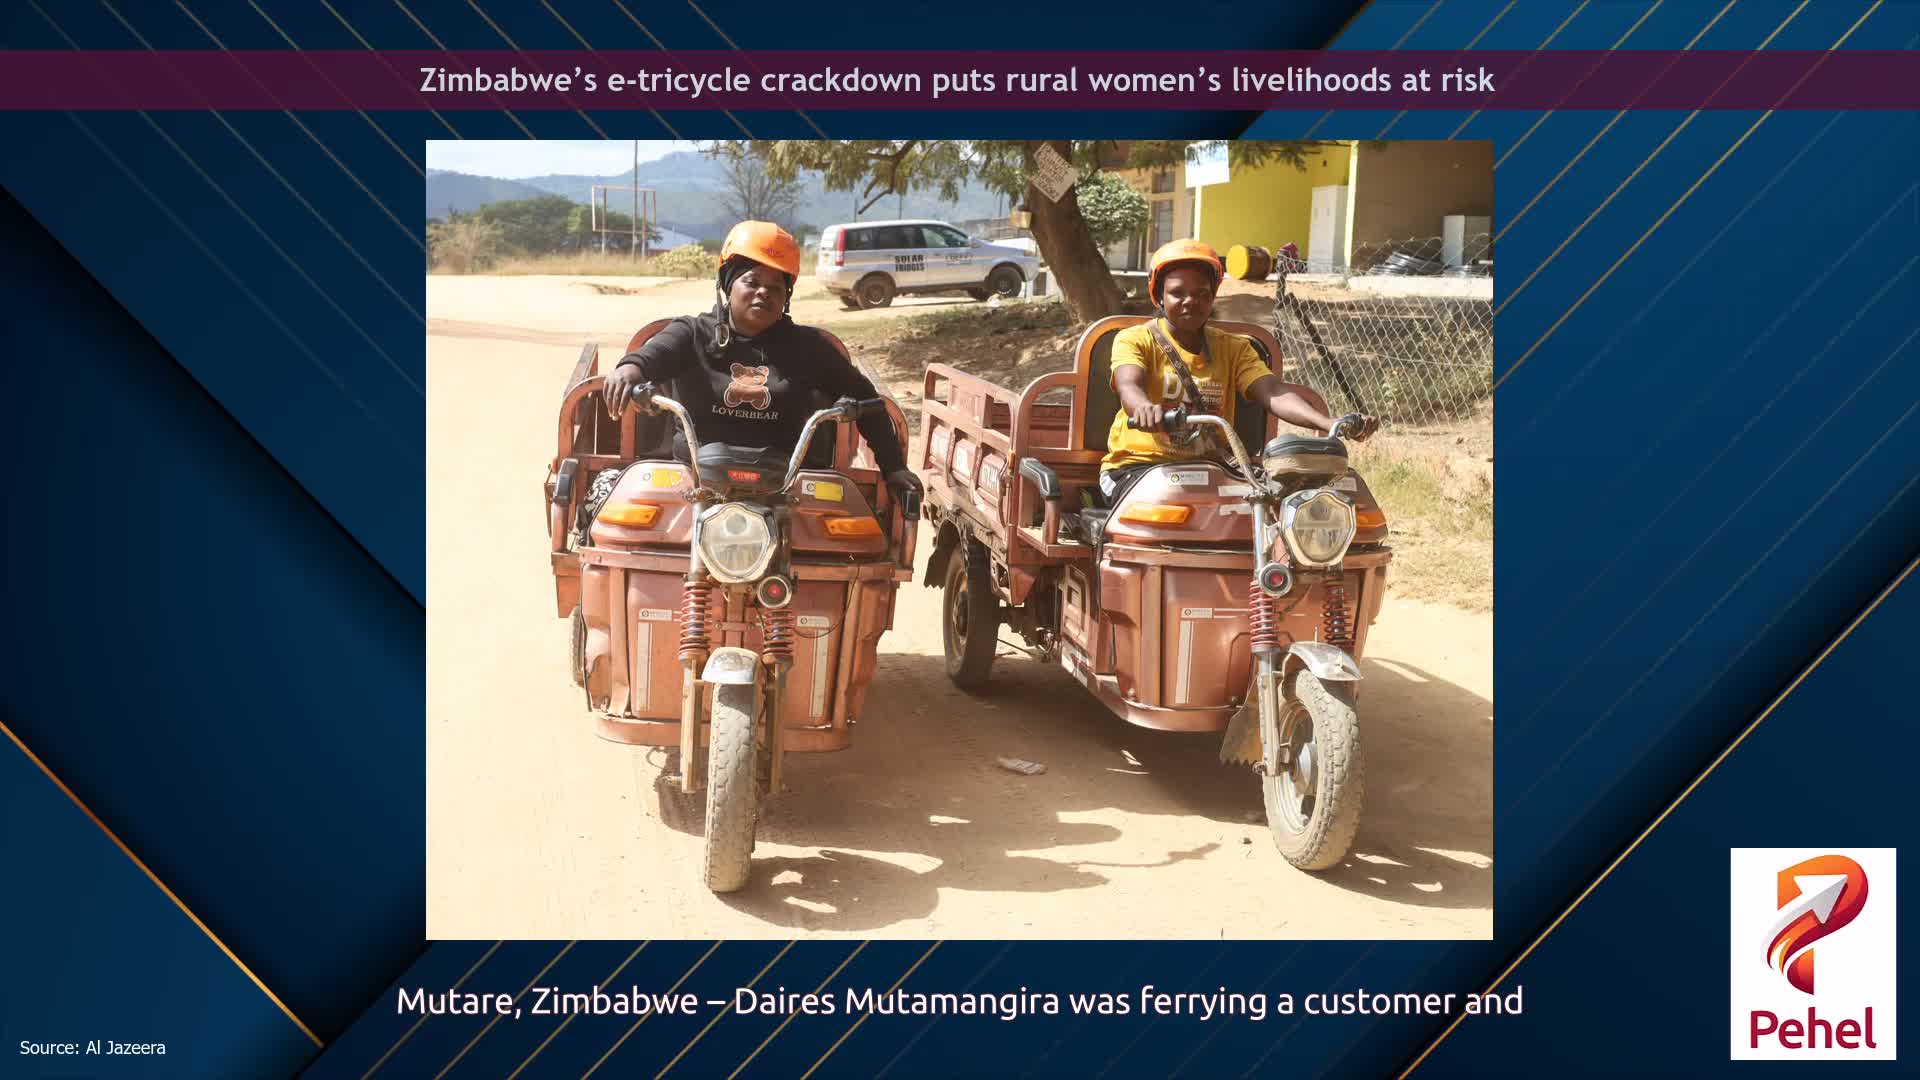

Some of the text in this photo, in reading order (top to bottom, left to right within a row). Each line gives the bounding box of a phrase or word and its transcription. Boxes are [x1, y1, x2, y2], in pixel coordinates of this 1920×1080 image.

[894, 254, 924, 264] SOLAR
[895, 263, 925, 272] FRIDGES
[711, 405, 779, 420] LOVERBEAR
